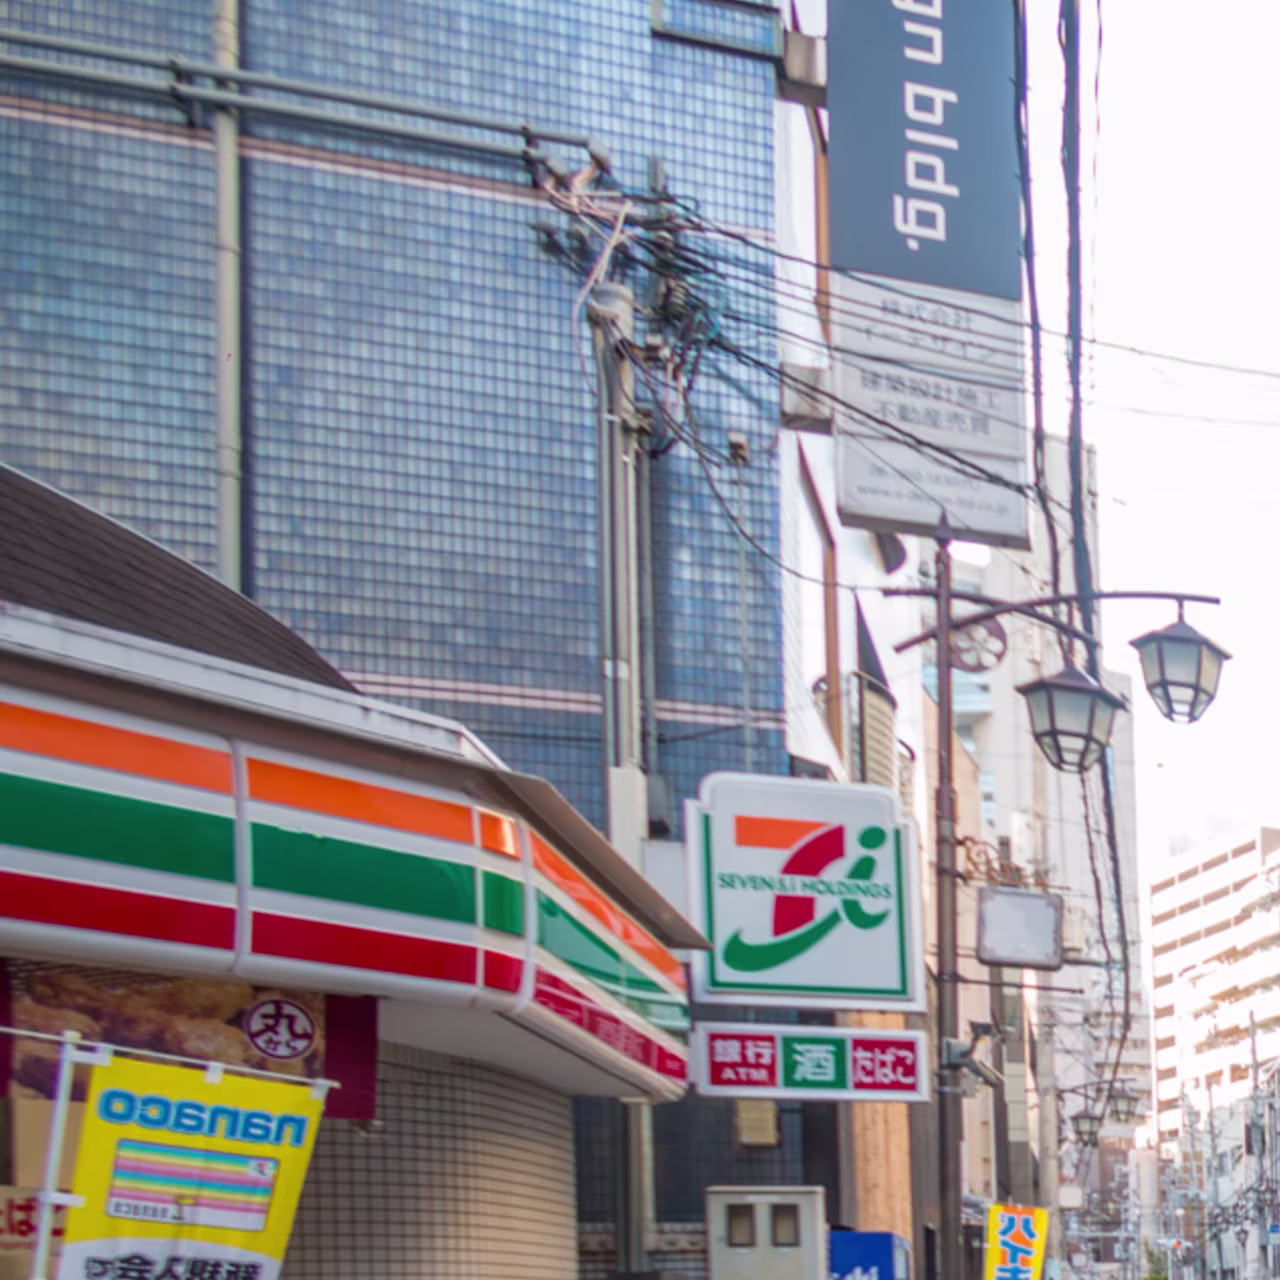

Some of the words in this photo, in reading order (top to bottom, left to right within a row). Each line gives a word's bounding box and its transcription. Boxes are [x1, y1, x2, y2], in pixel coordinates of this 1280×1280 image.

[893, 81, 960, 251] bldg.
[801, 878, 892, 898] HOLDINGS
[712, 1038, 775, 1065] 銀行
[793, 1043, 837, 1083] 酒
[853, 1046, 915, 1085] たばこ
[721, 1065, 770, 1082] ATM
